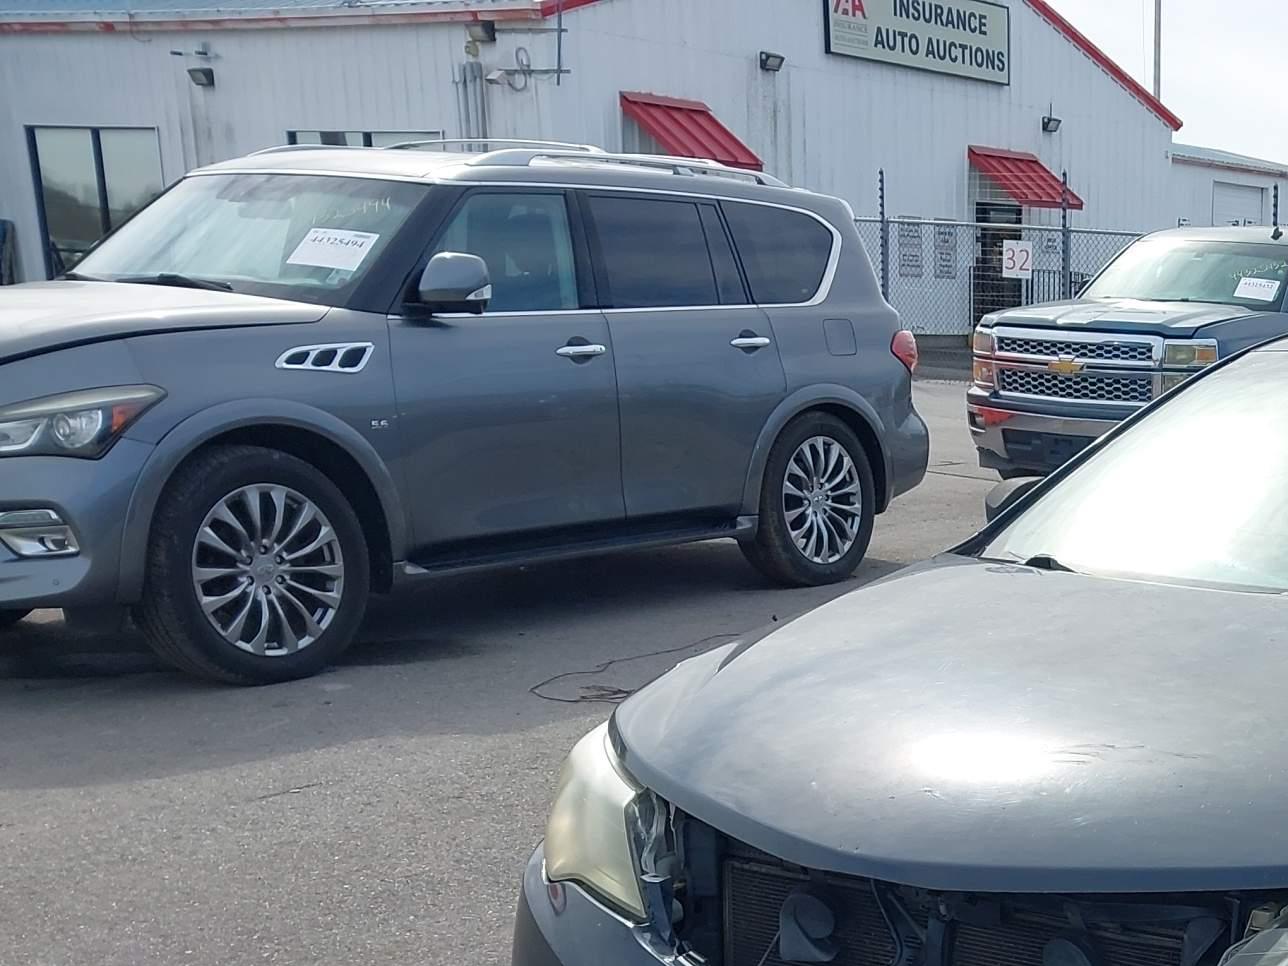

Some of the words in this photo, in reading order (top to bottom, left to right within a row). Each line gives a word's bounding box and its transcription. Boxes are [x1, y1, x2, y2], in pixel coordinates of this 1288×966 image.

[893, 0, 988, 36] INSURANCE
[874, 26, 920, 55] AUTO
[925, 37, 1006, 72] AUCTIONS
[1004, 247, 1030, 272] 32
